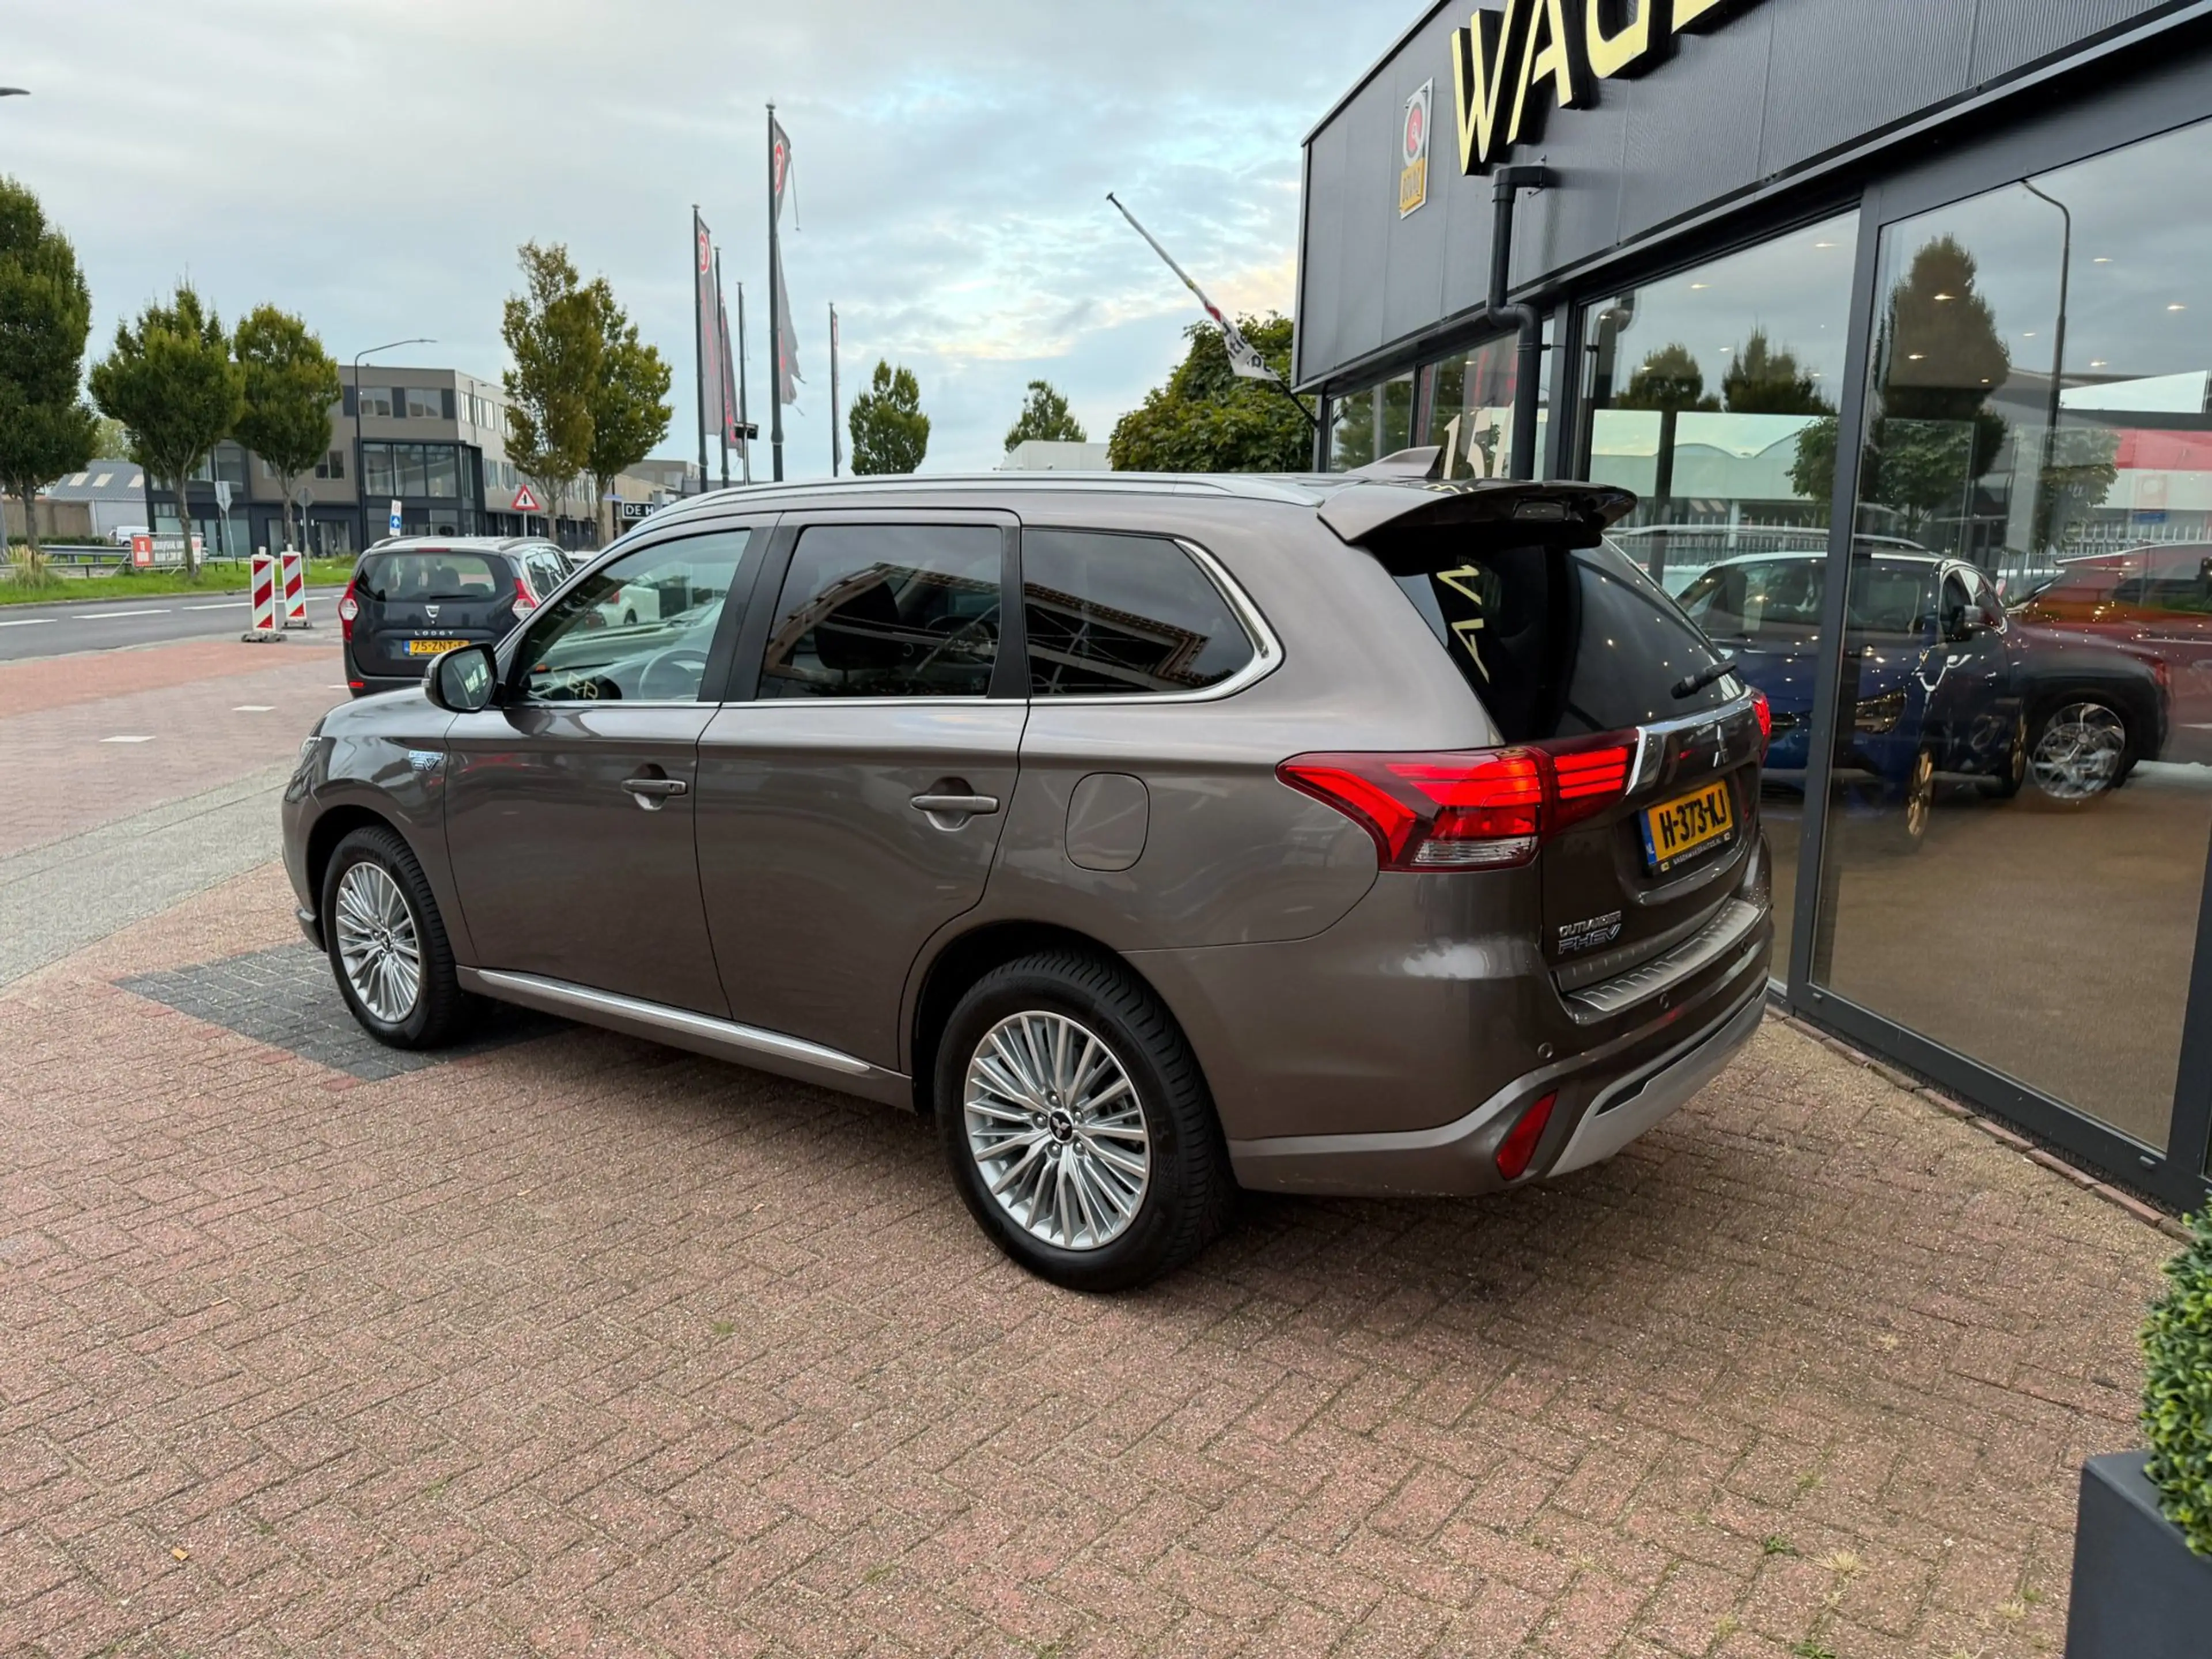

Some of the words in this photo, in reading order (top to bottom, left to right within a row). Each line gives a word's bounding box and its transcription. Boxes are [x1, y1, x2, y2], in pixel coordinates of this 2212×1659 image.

[626, 505, 641, 516] DE
[1659, 789, 1727, 850] H-373-KJ
[1559, 910, 1622, 937] OUTLANDER
[1558, 923, 1622, 955] PHEV
